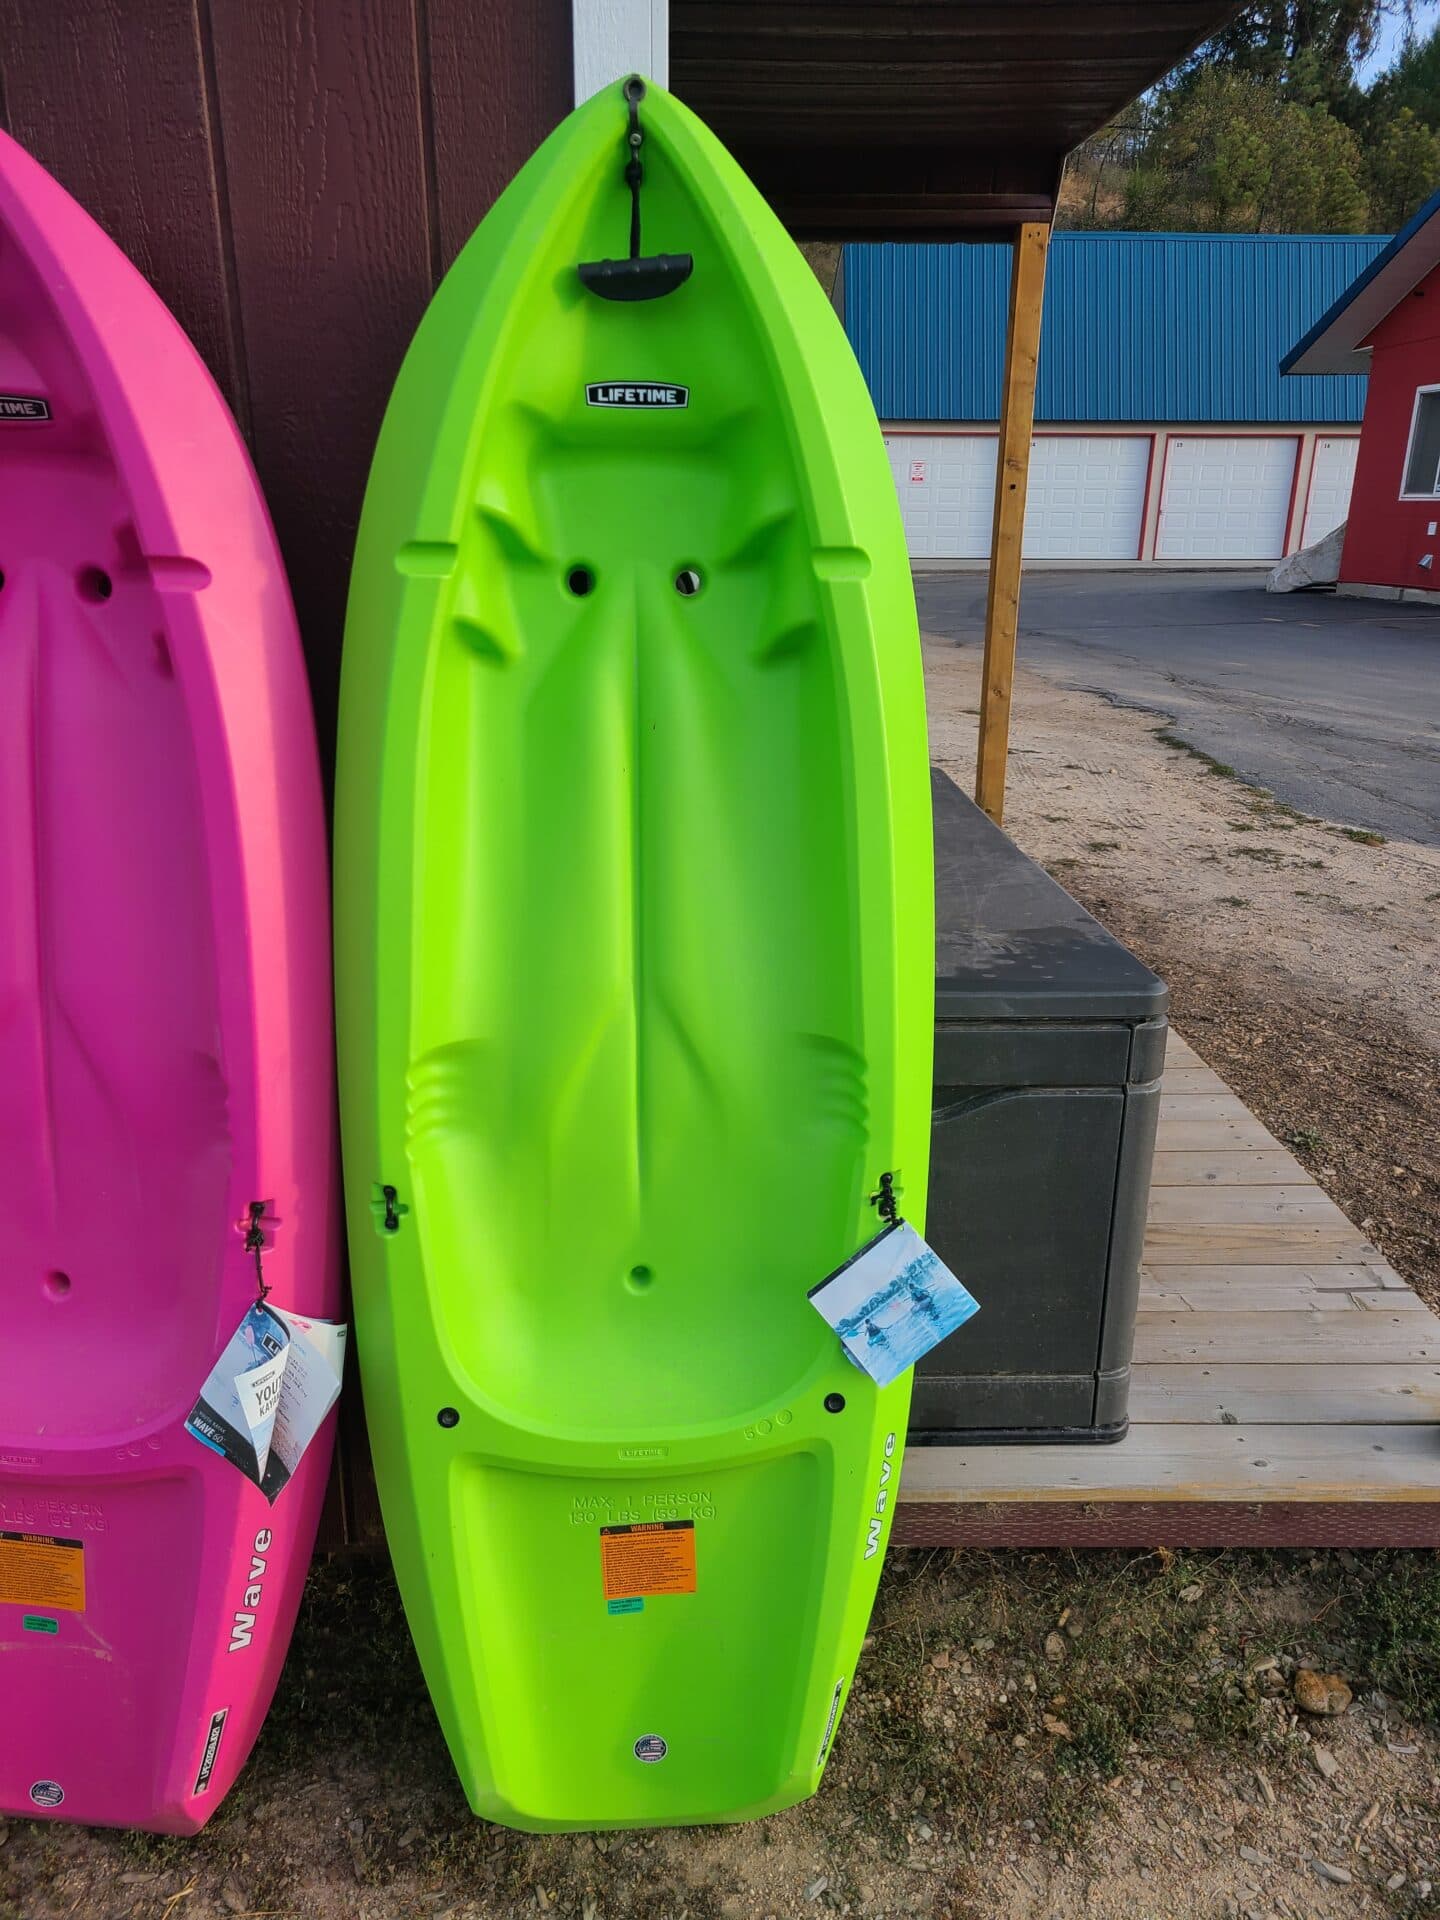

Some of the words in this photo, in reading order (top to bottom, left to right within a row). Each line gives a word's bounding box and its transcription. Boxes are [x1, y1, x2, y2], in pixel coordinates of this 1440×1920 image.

[597, 387, 677, 404] LIFETIME
[192, 1416, 216, 1438] WAVE
[643, 1491, 713, 1507] PERSON
[864, 1432, 896, 1560] Wave
[34, 1498, 104, 1516] PERSON
[569, 1510, 597, 1526] 130
[607, 1510, 641, 1524] LBS
[630, 1522, 665, 1533] WARNING
[22, 1533, 55, 1545] WARNING
[228, 1528, 273, 1653] Wave
